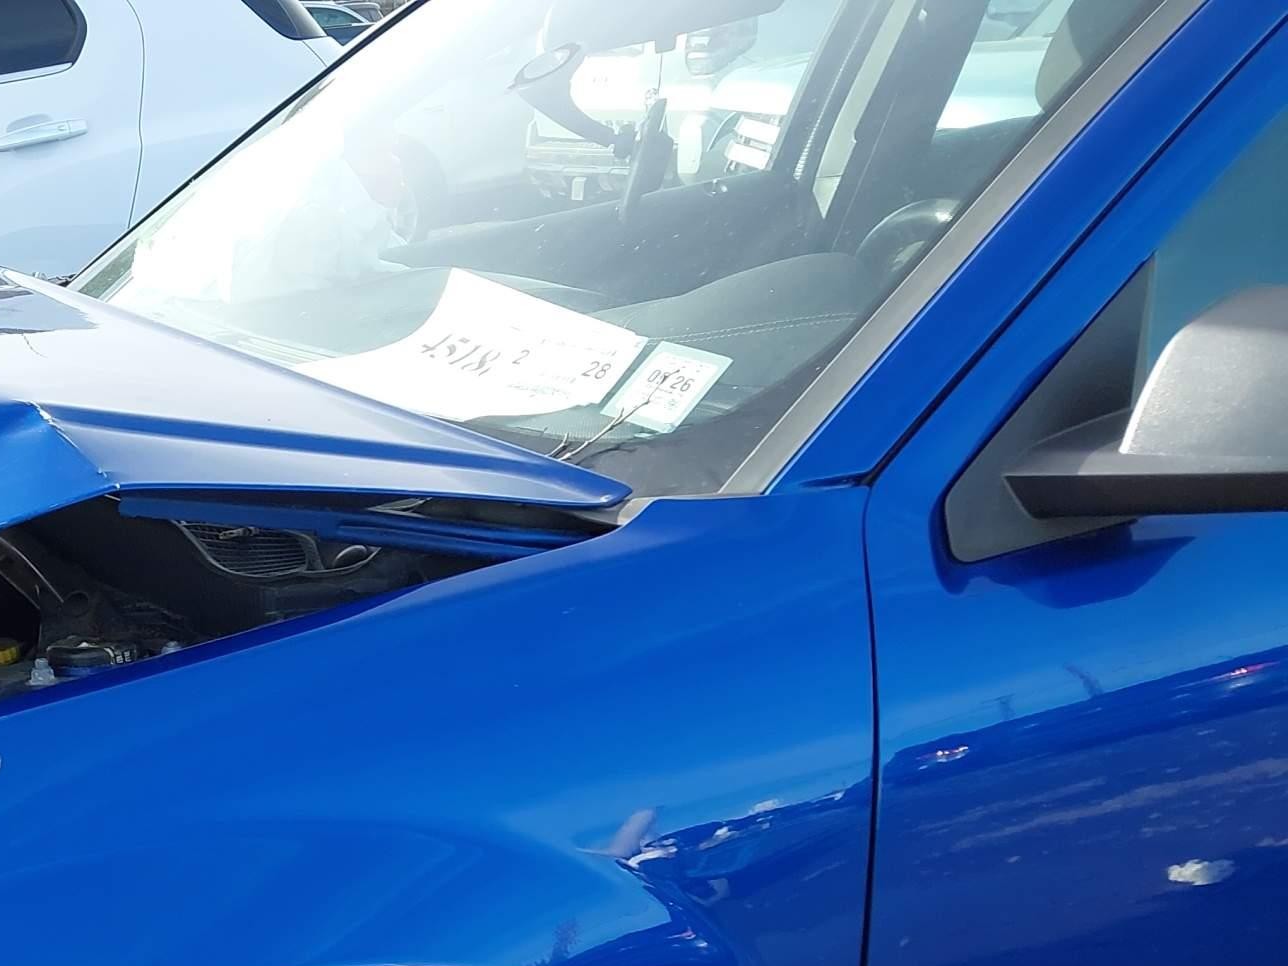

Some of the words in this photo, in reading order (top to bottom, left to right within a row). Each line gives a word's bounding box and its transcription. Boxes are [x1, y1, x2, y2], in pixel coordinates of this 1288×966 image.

[511, 348, 531, 365] 2
[581, 361, 612, 380] 28
[669, 375, 695, 392] 26
